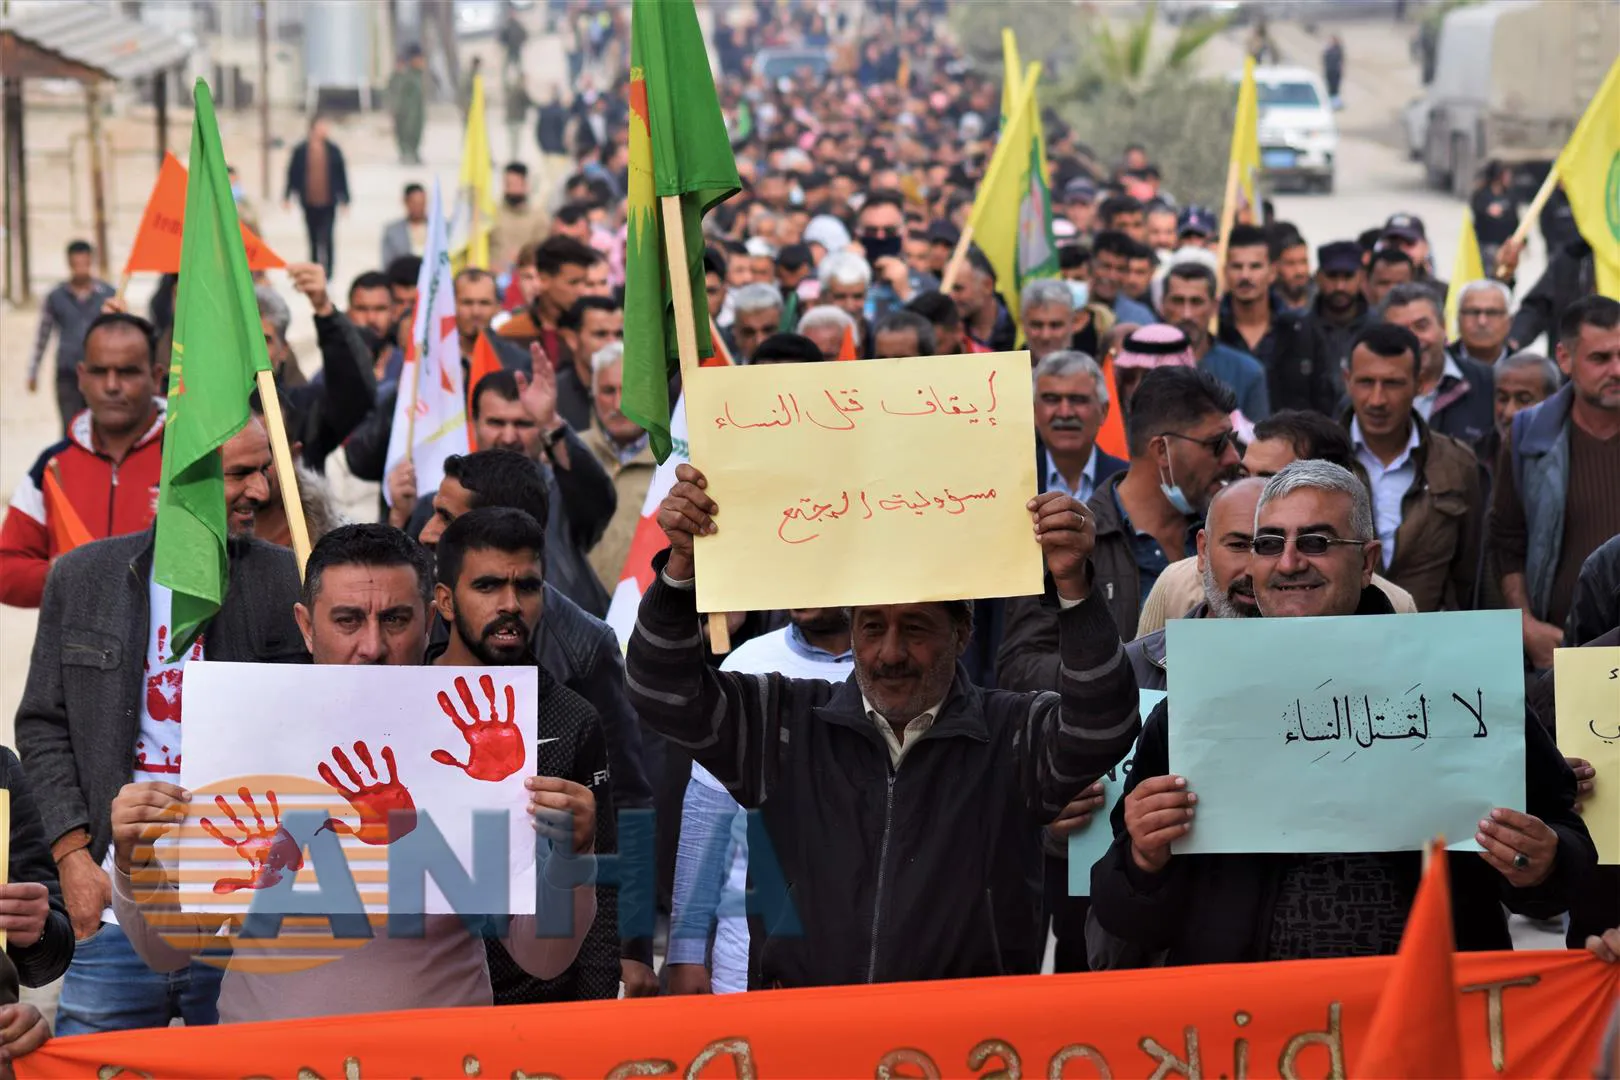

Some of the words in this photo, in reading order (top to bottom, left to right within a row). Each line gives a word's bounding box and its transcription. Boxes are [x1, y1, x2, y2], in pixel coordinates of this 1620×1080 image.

[715, 393, 800, 430] النساء
[806, 389, 864, 431] قتل
[881, 370, 996, 426] إيقاف
[1452, 688, 1488, 738] لا
